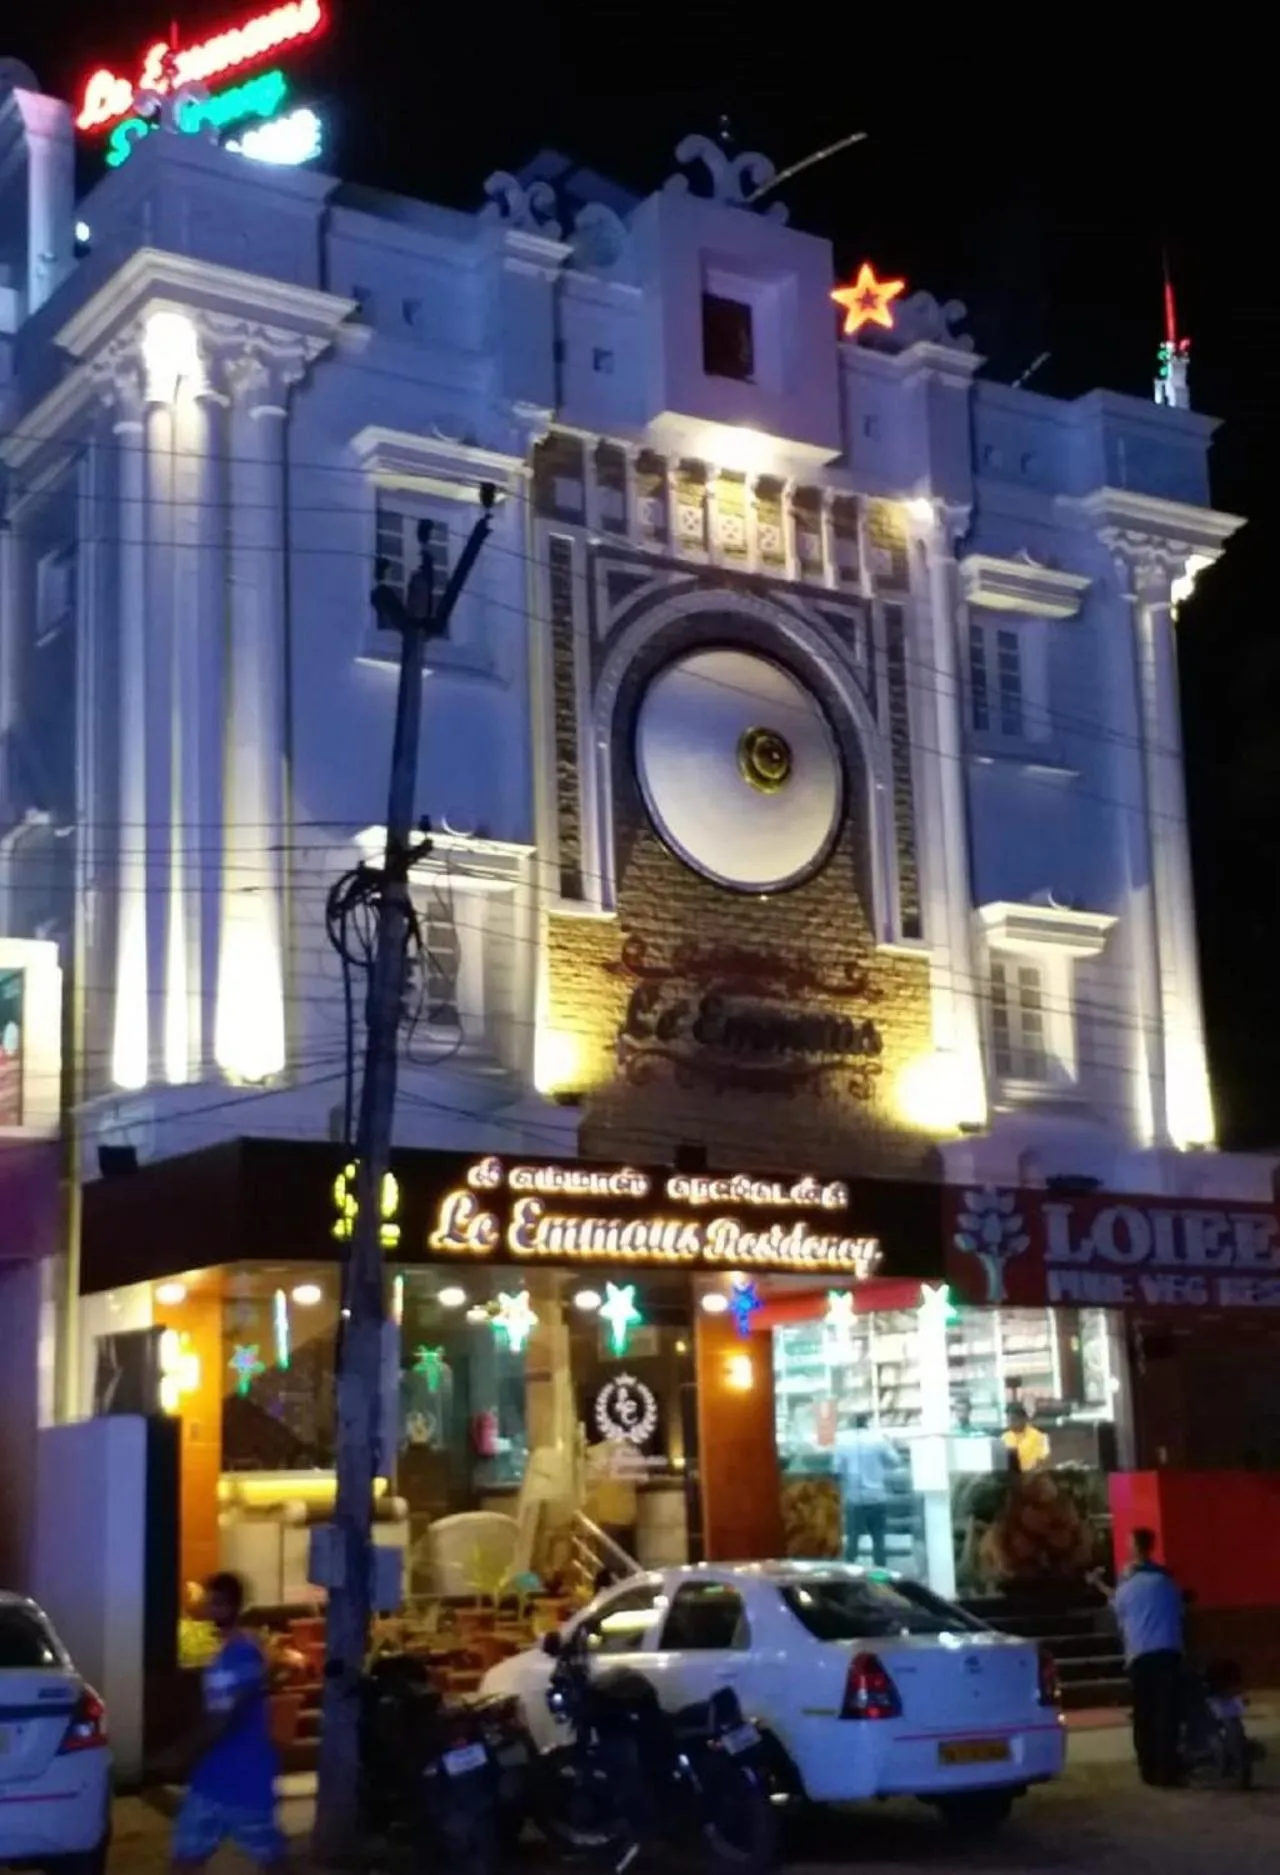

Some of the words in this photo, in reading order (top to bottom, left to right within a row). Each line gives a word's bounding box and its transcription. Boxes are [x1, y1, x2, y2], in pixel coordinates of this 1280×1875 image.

[430, 1189, 499, 1252] Le
[507, 1197, 701, 1261] Emmaus
[703, 1216, 883, 1279] Residency
[1139, 1273, 1209, 1306] VEG
